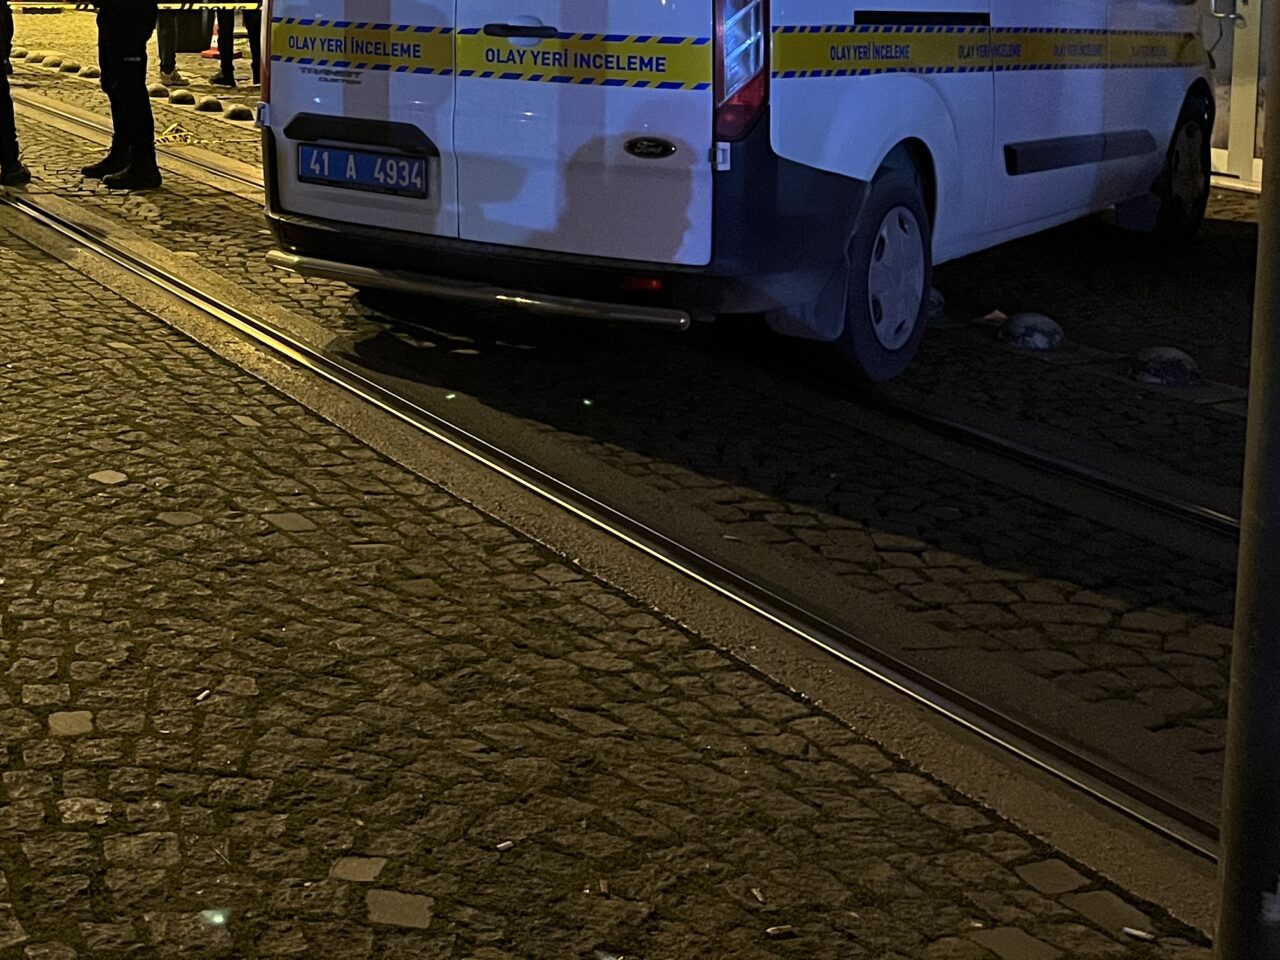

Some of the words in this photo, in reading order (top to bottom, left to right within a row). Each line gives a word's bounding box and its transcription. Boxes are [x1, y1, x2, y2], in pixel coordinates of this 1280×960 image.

[288, 35, 317, 51] OLAY
[319, 36, 347, 53] YERİ
[351, 37, 421, 59] İNCELEME
[485, 48, 527, 66] OLAY
[531, 48, 568, 67] YERİ
[830, 45, 851, 61] OLAY
[310, 150, 329, 176] 41
[346, 154, 357, 180] A
[373, 157, 423, 189] 4934
